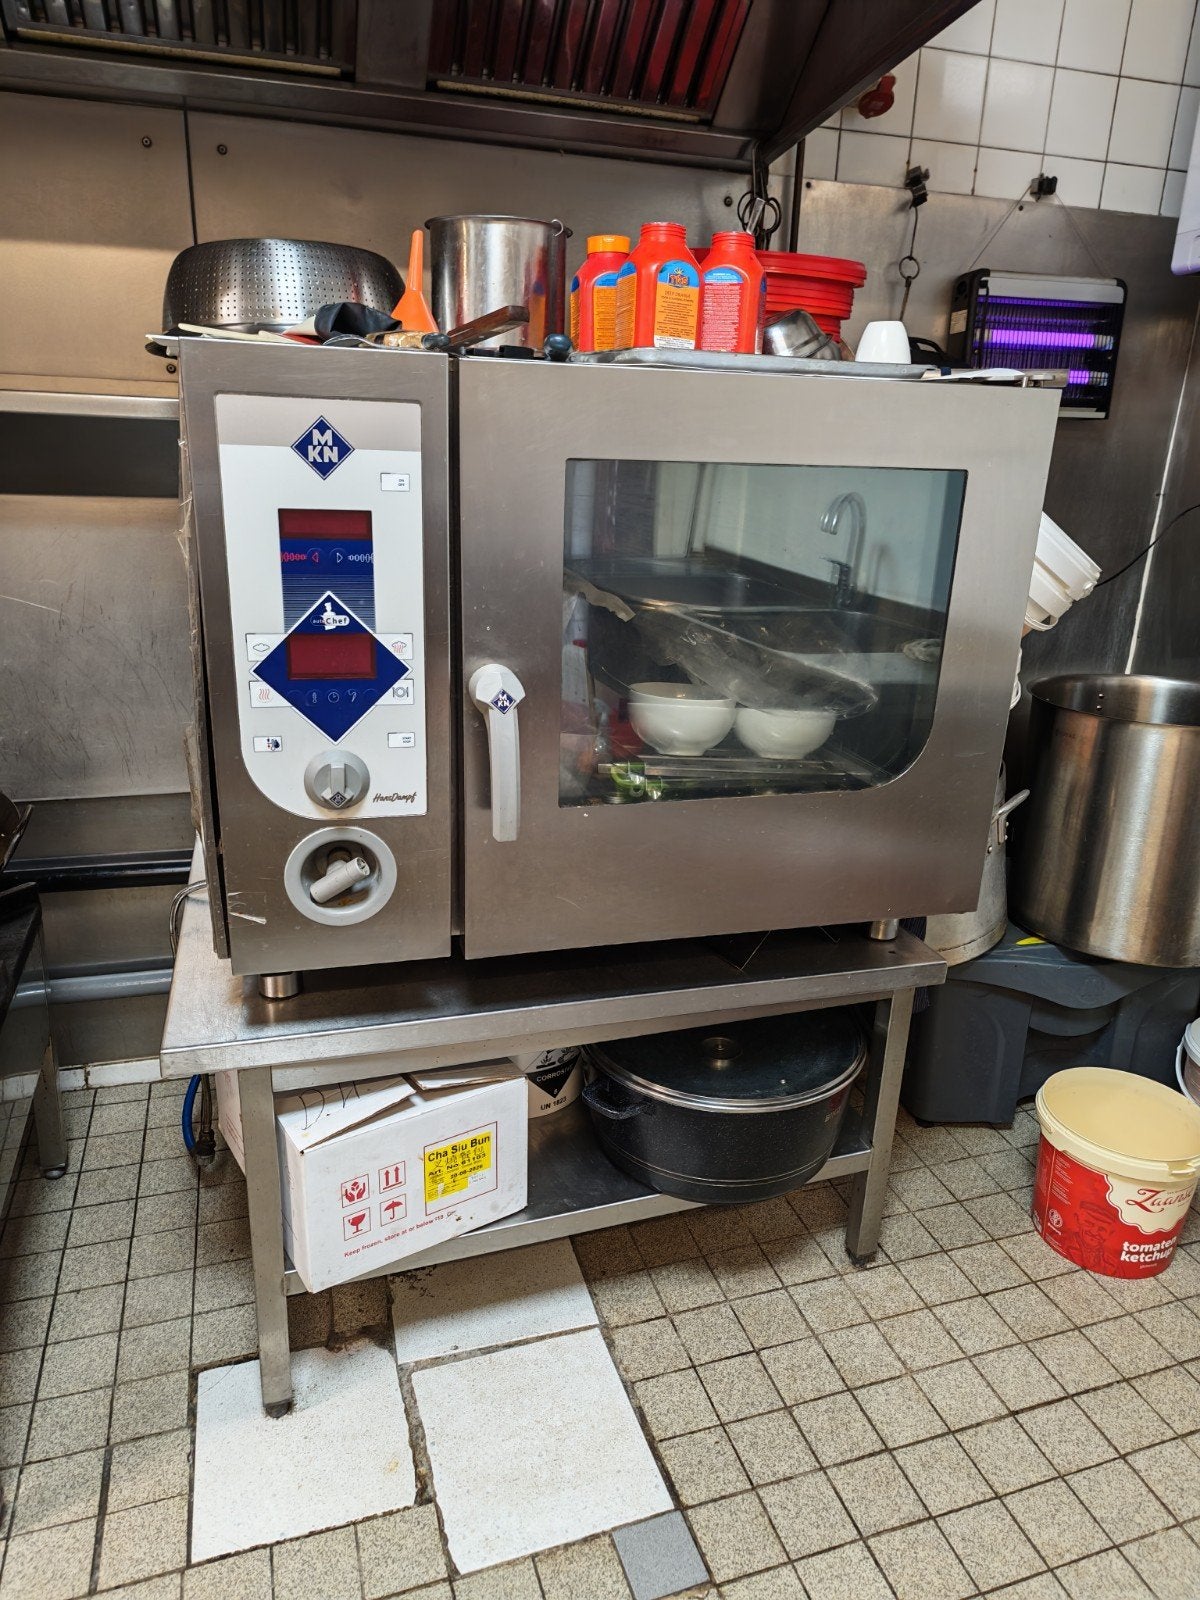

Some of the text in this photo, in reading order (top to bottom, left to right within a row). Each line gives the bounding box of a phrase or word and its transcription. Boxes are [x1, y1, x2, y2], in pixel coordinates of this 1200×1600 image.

[312, 429, 333, 446] M
[308, 445, 338, 463] KN
[428, 1136, 490, 1162] Cha Siu Bun
[343, 1248, 360, 1257] Keep
[384, 1232, 400, 1242] store
[415, 1218, 434, 1229] below
[1122, 1236, 1178, 1253] tomaten
[1120, 1247, 1174, 1263] ketchup
